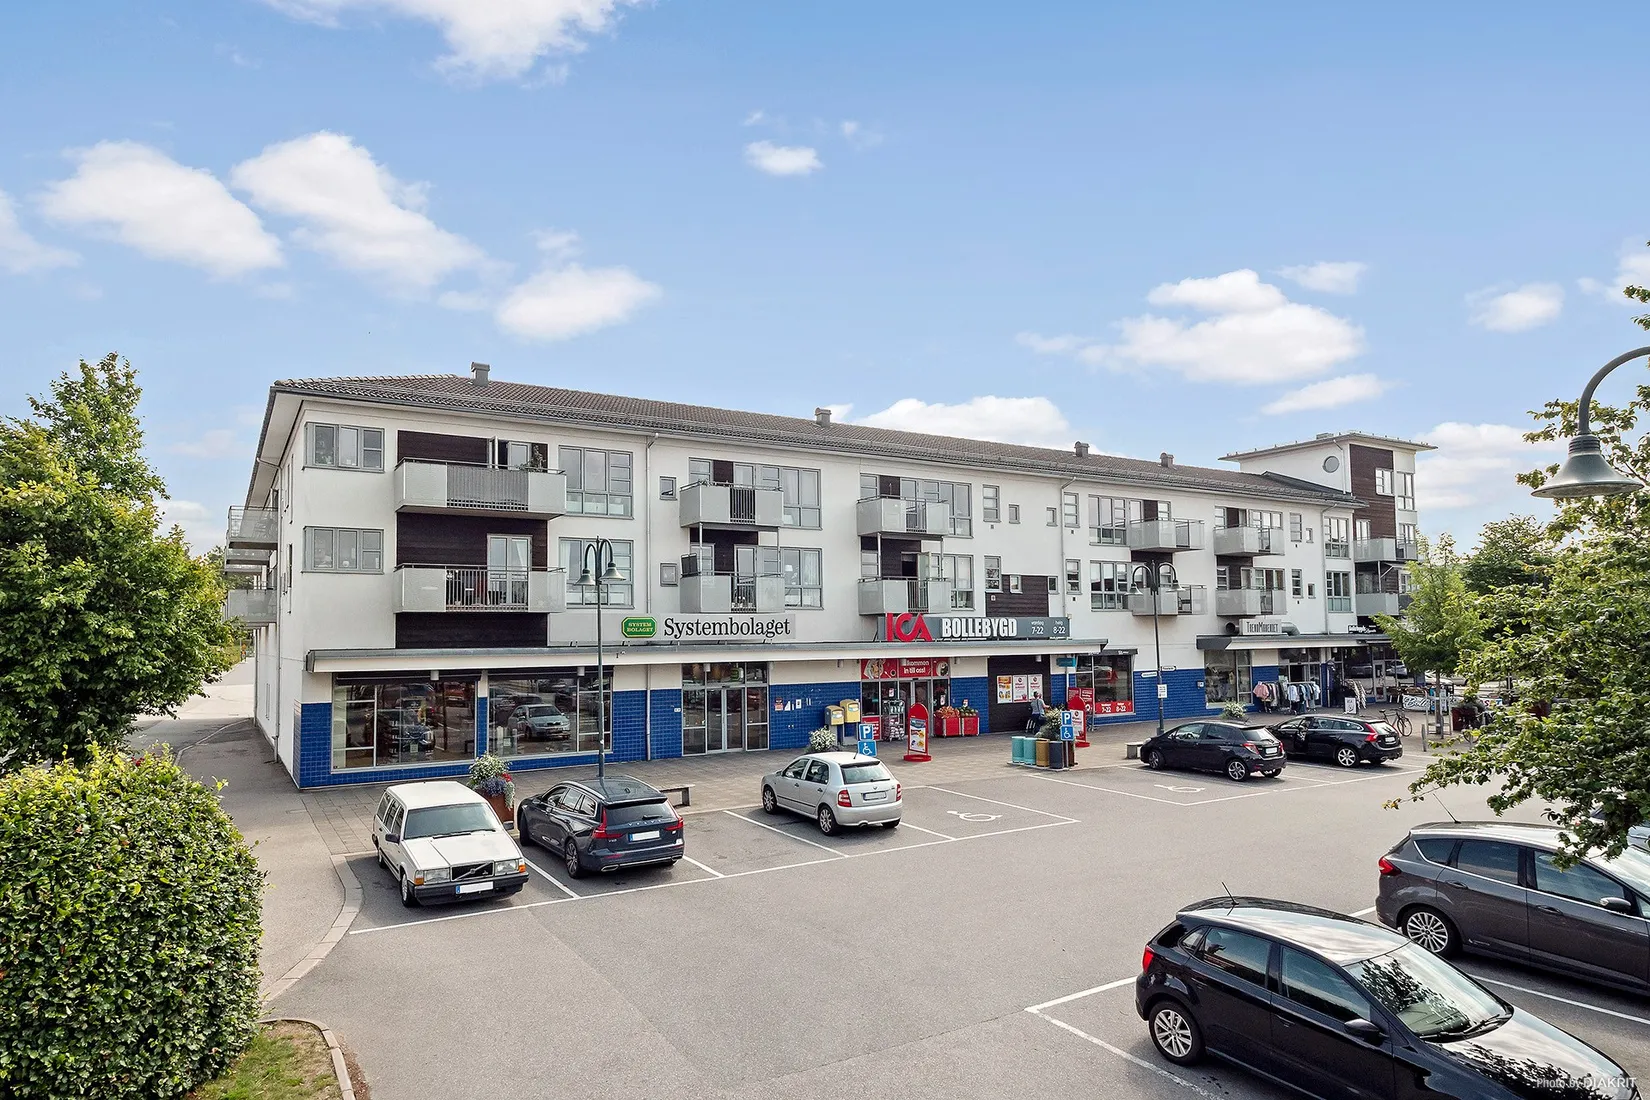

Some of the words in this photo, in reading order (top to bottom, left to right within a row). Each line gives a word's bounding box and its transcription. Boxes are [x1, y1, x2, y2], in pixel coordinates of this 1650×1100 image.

[664, 617, 791, 639] Systembolaget
[885, 612, 933, 642] ICA
[941, 618, 1017, 638] BOLLEBYGD
[1031, 626, 1044, 634] 7-22
[1052, 626, 1066, 634] 8-22
[1064, 713, 1071, 724] P
[862, 726, 871, 739] P
